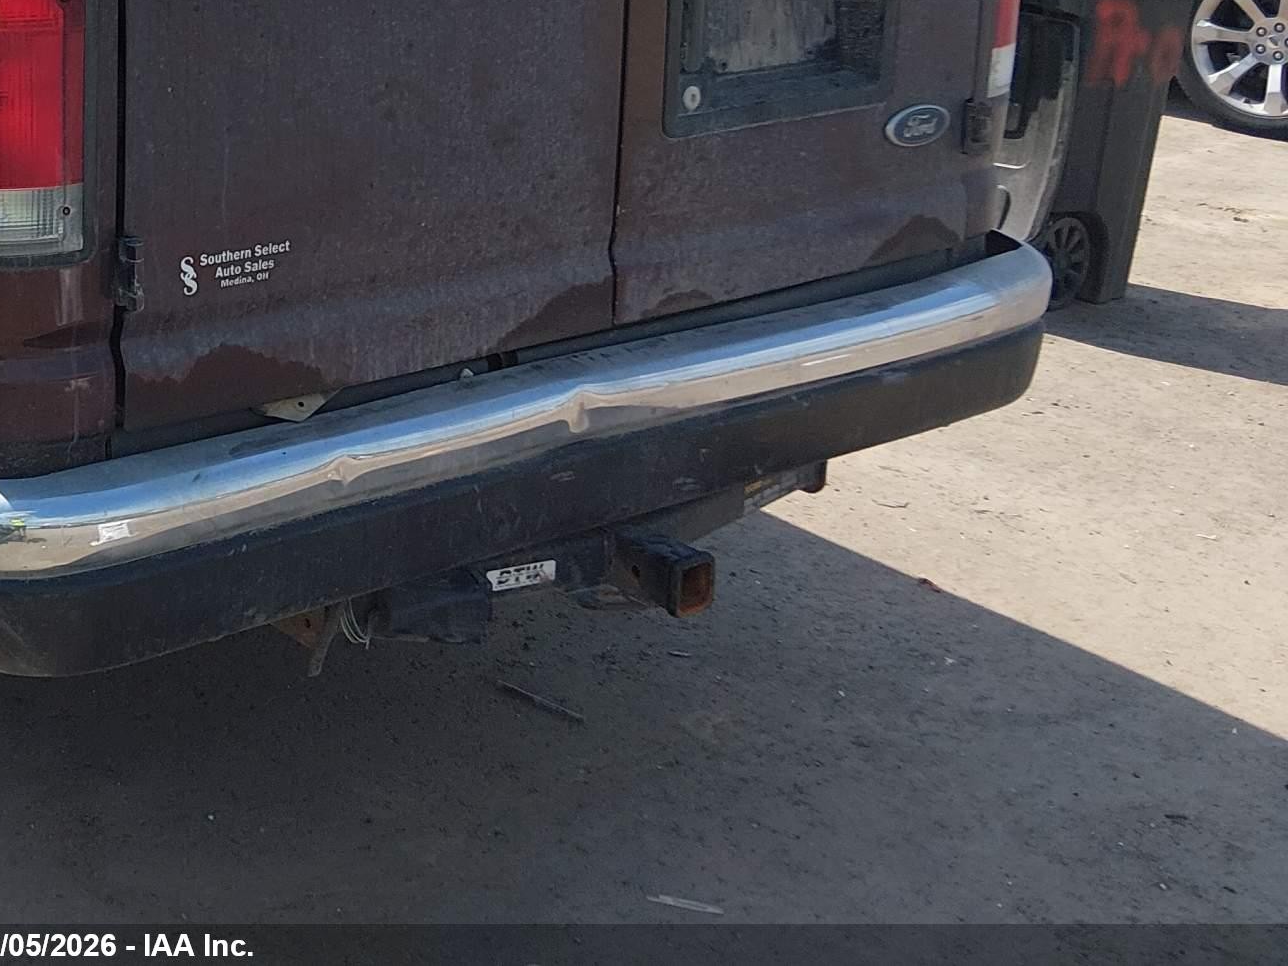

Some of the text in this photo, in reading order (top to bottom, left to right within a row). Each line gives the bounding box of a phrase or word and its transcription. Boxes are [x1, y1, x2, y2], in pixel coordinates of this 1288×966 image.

[200, 240, 290, 266] Southern Select
[215, 259, 275, 278] Auto Sales
